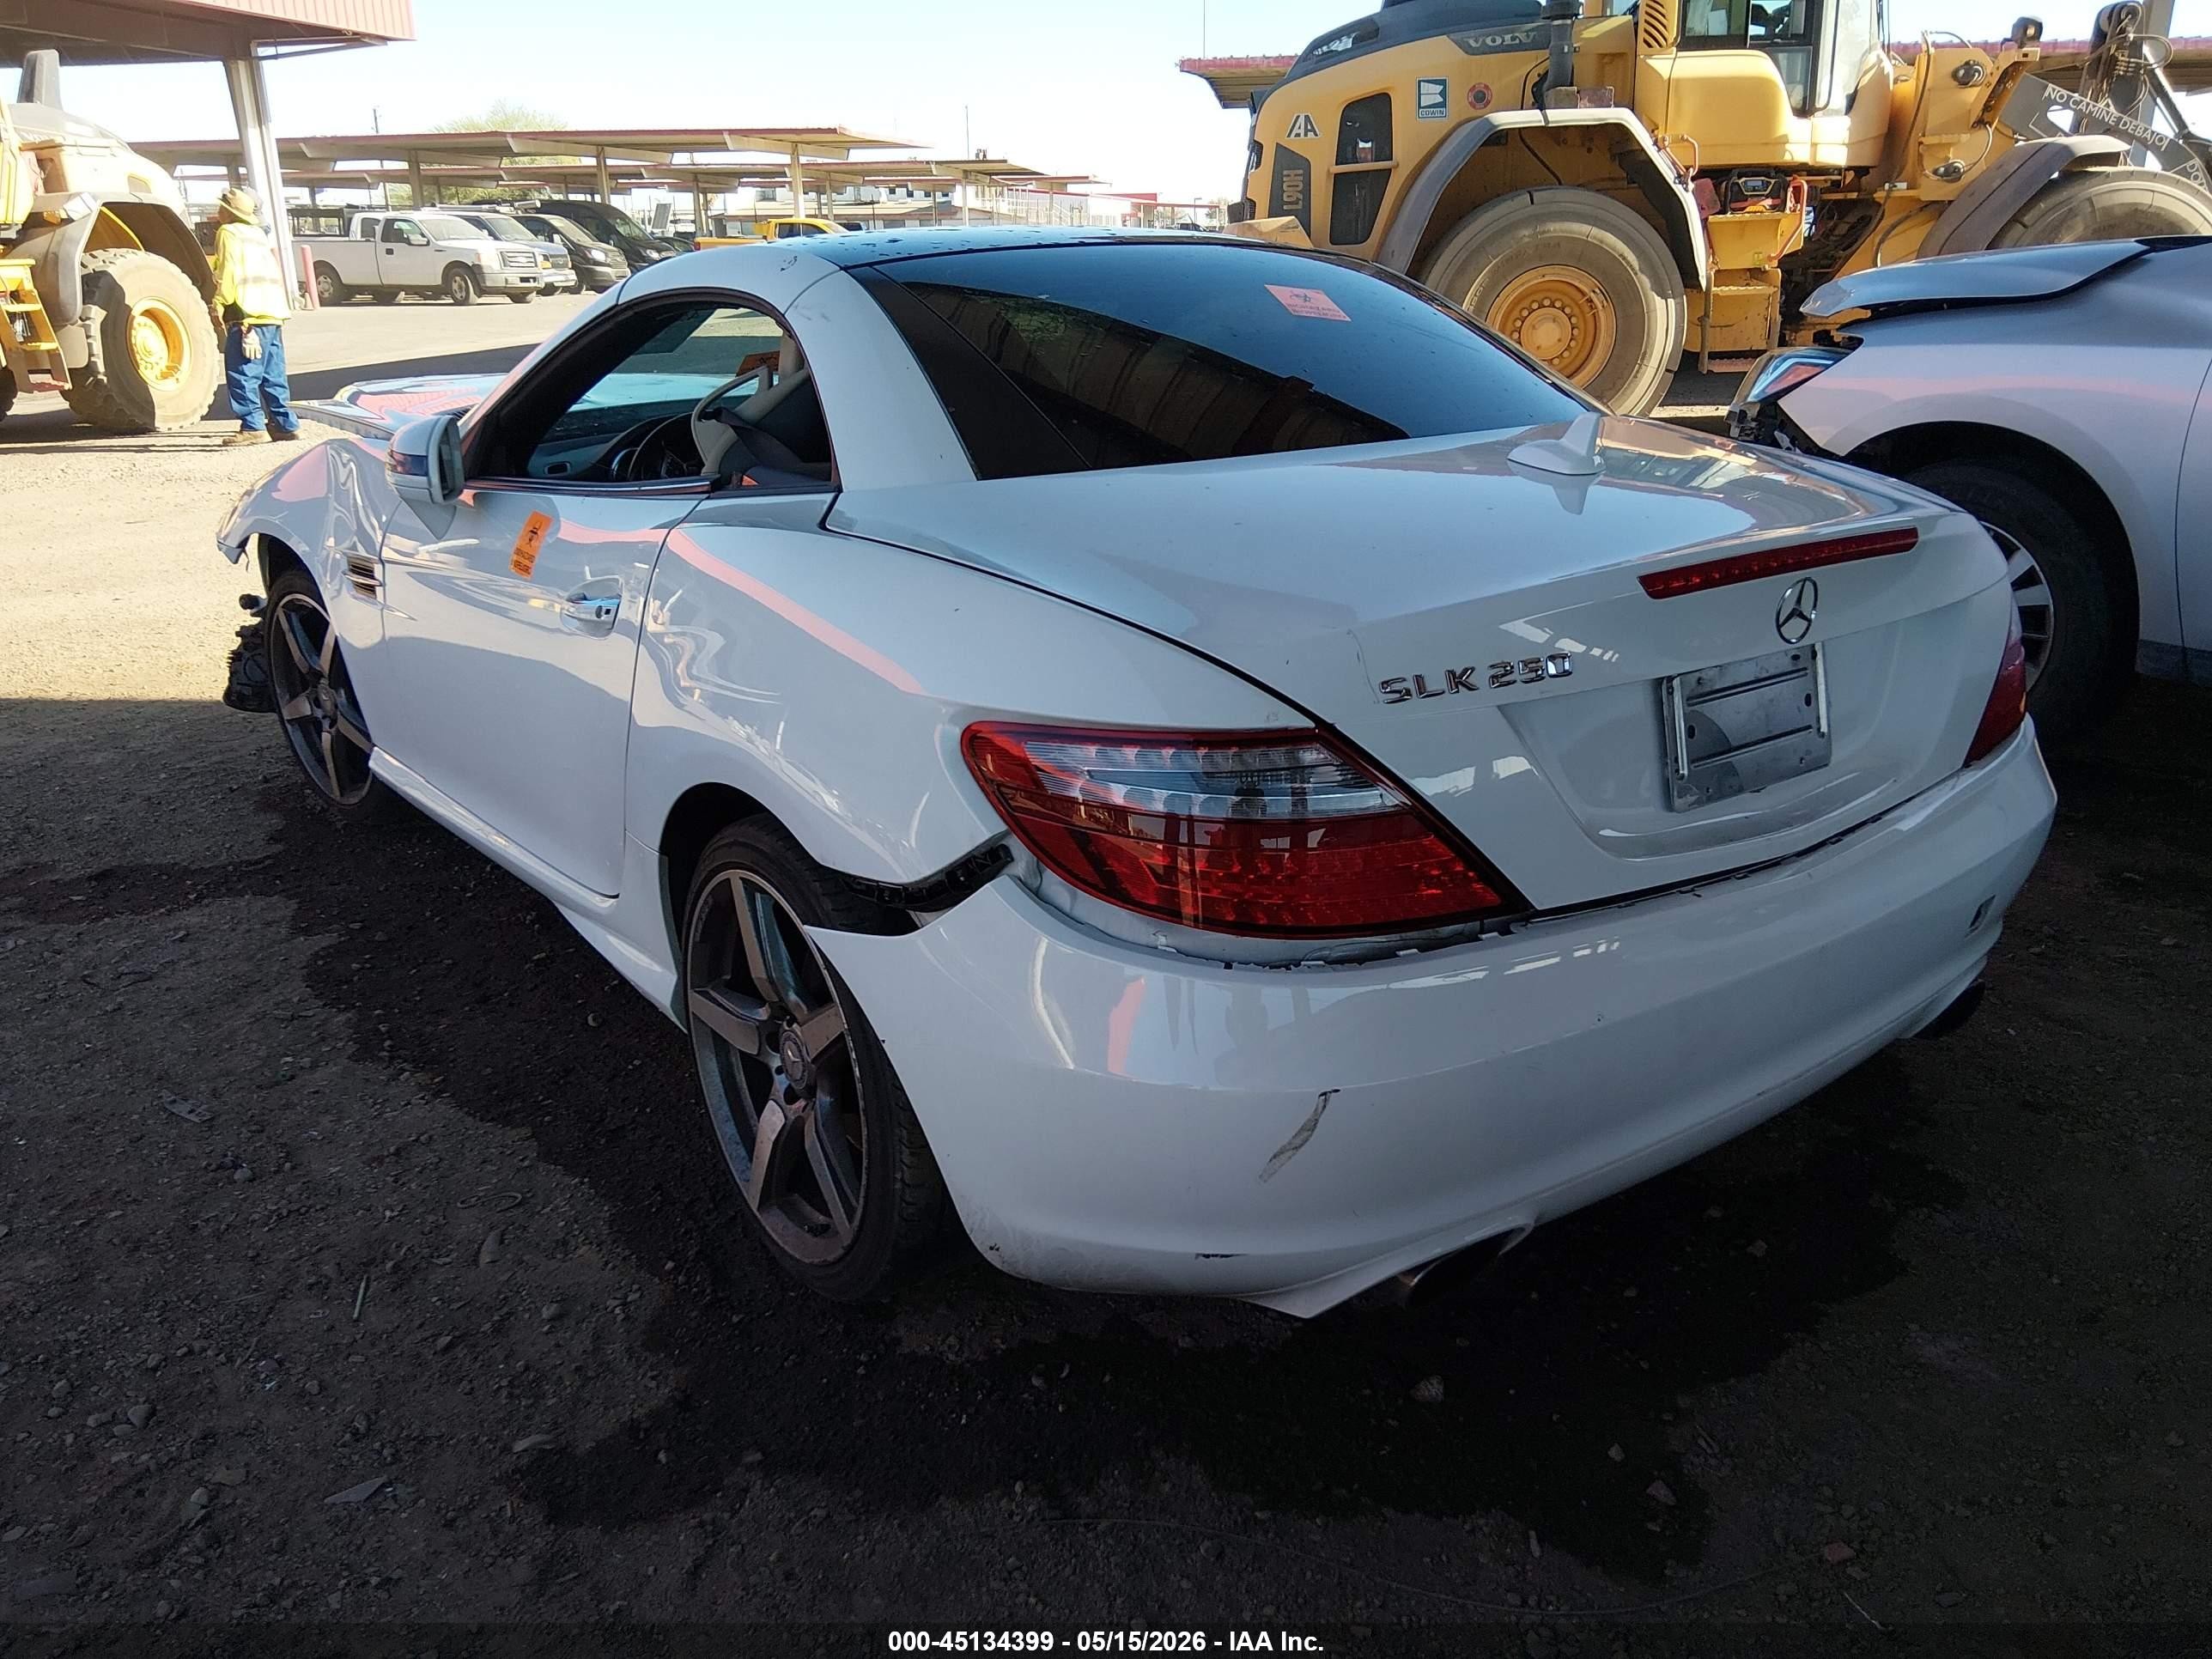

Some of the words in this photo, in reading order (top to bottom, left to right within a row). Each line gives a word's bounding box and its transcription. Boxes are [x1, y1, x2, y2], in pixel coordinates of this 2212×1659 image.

[2044, 87, 2068, 104] NO
[2069, 95, 2118, 126] CAMINE
[2118, 115, 2166, 147] DEBAJO
[1283, 169, 1304, 210] L90H
[1379, 665, 1479, 704] SLK
[1487, 651, 1573, 689] 250
